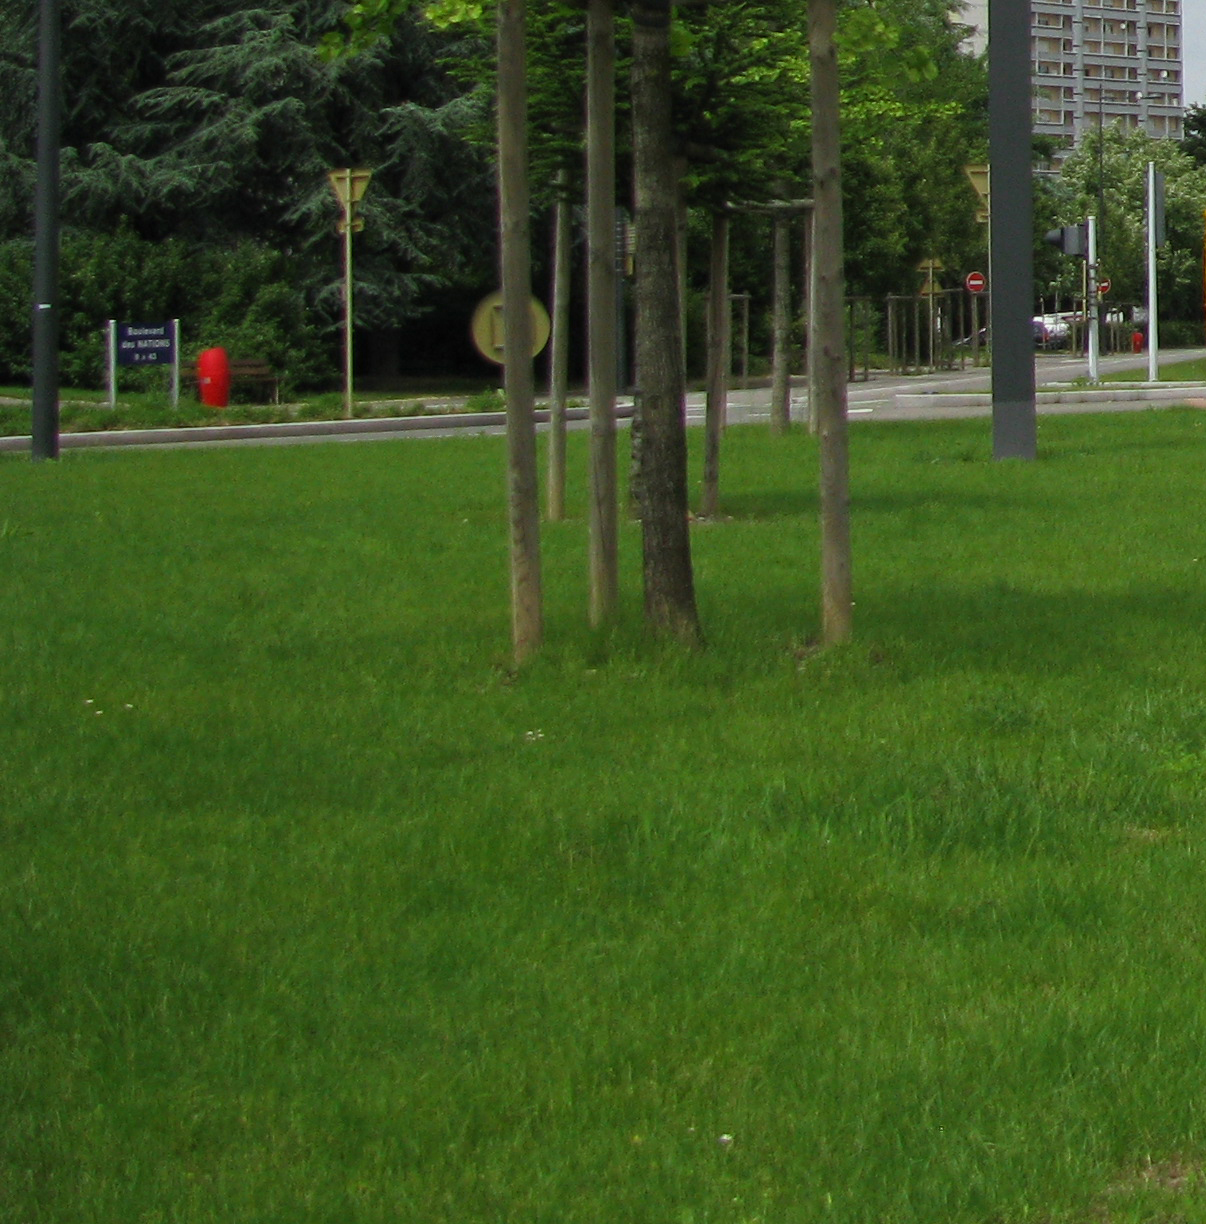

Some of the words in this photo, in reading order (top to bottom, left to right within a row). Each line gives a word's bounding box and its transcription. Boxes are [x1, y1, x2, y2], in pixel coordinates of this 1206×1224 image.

[127, 326, 165, 336] Boulevard
[122, 340, 136, 349] des
[137, 338, 170, 348] NATIONS
